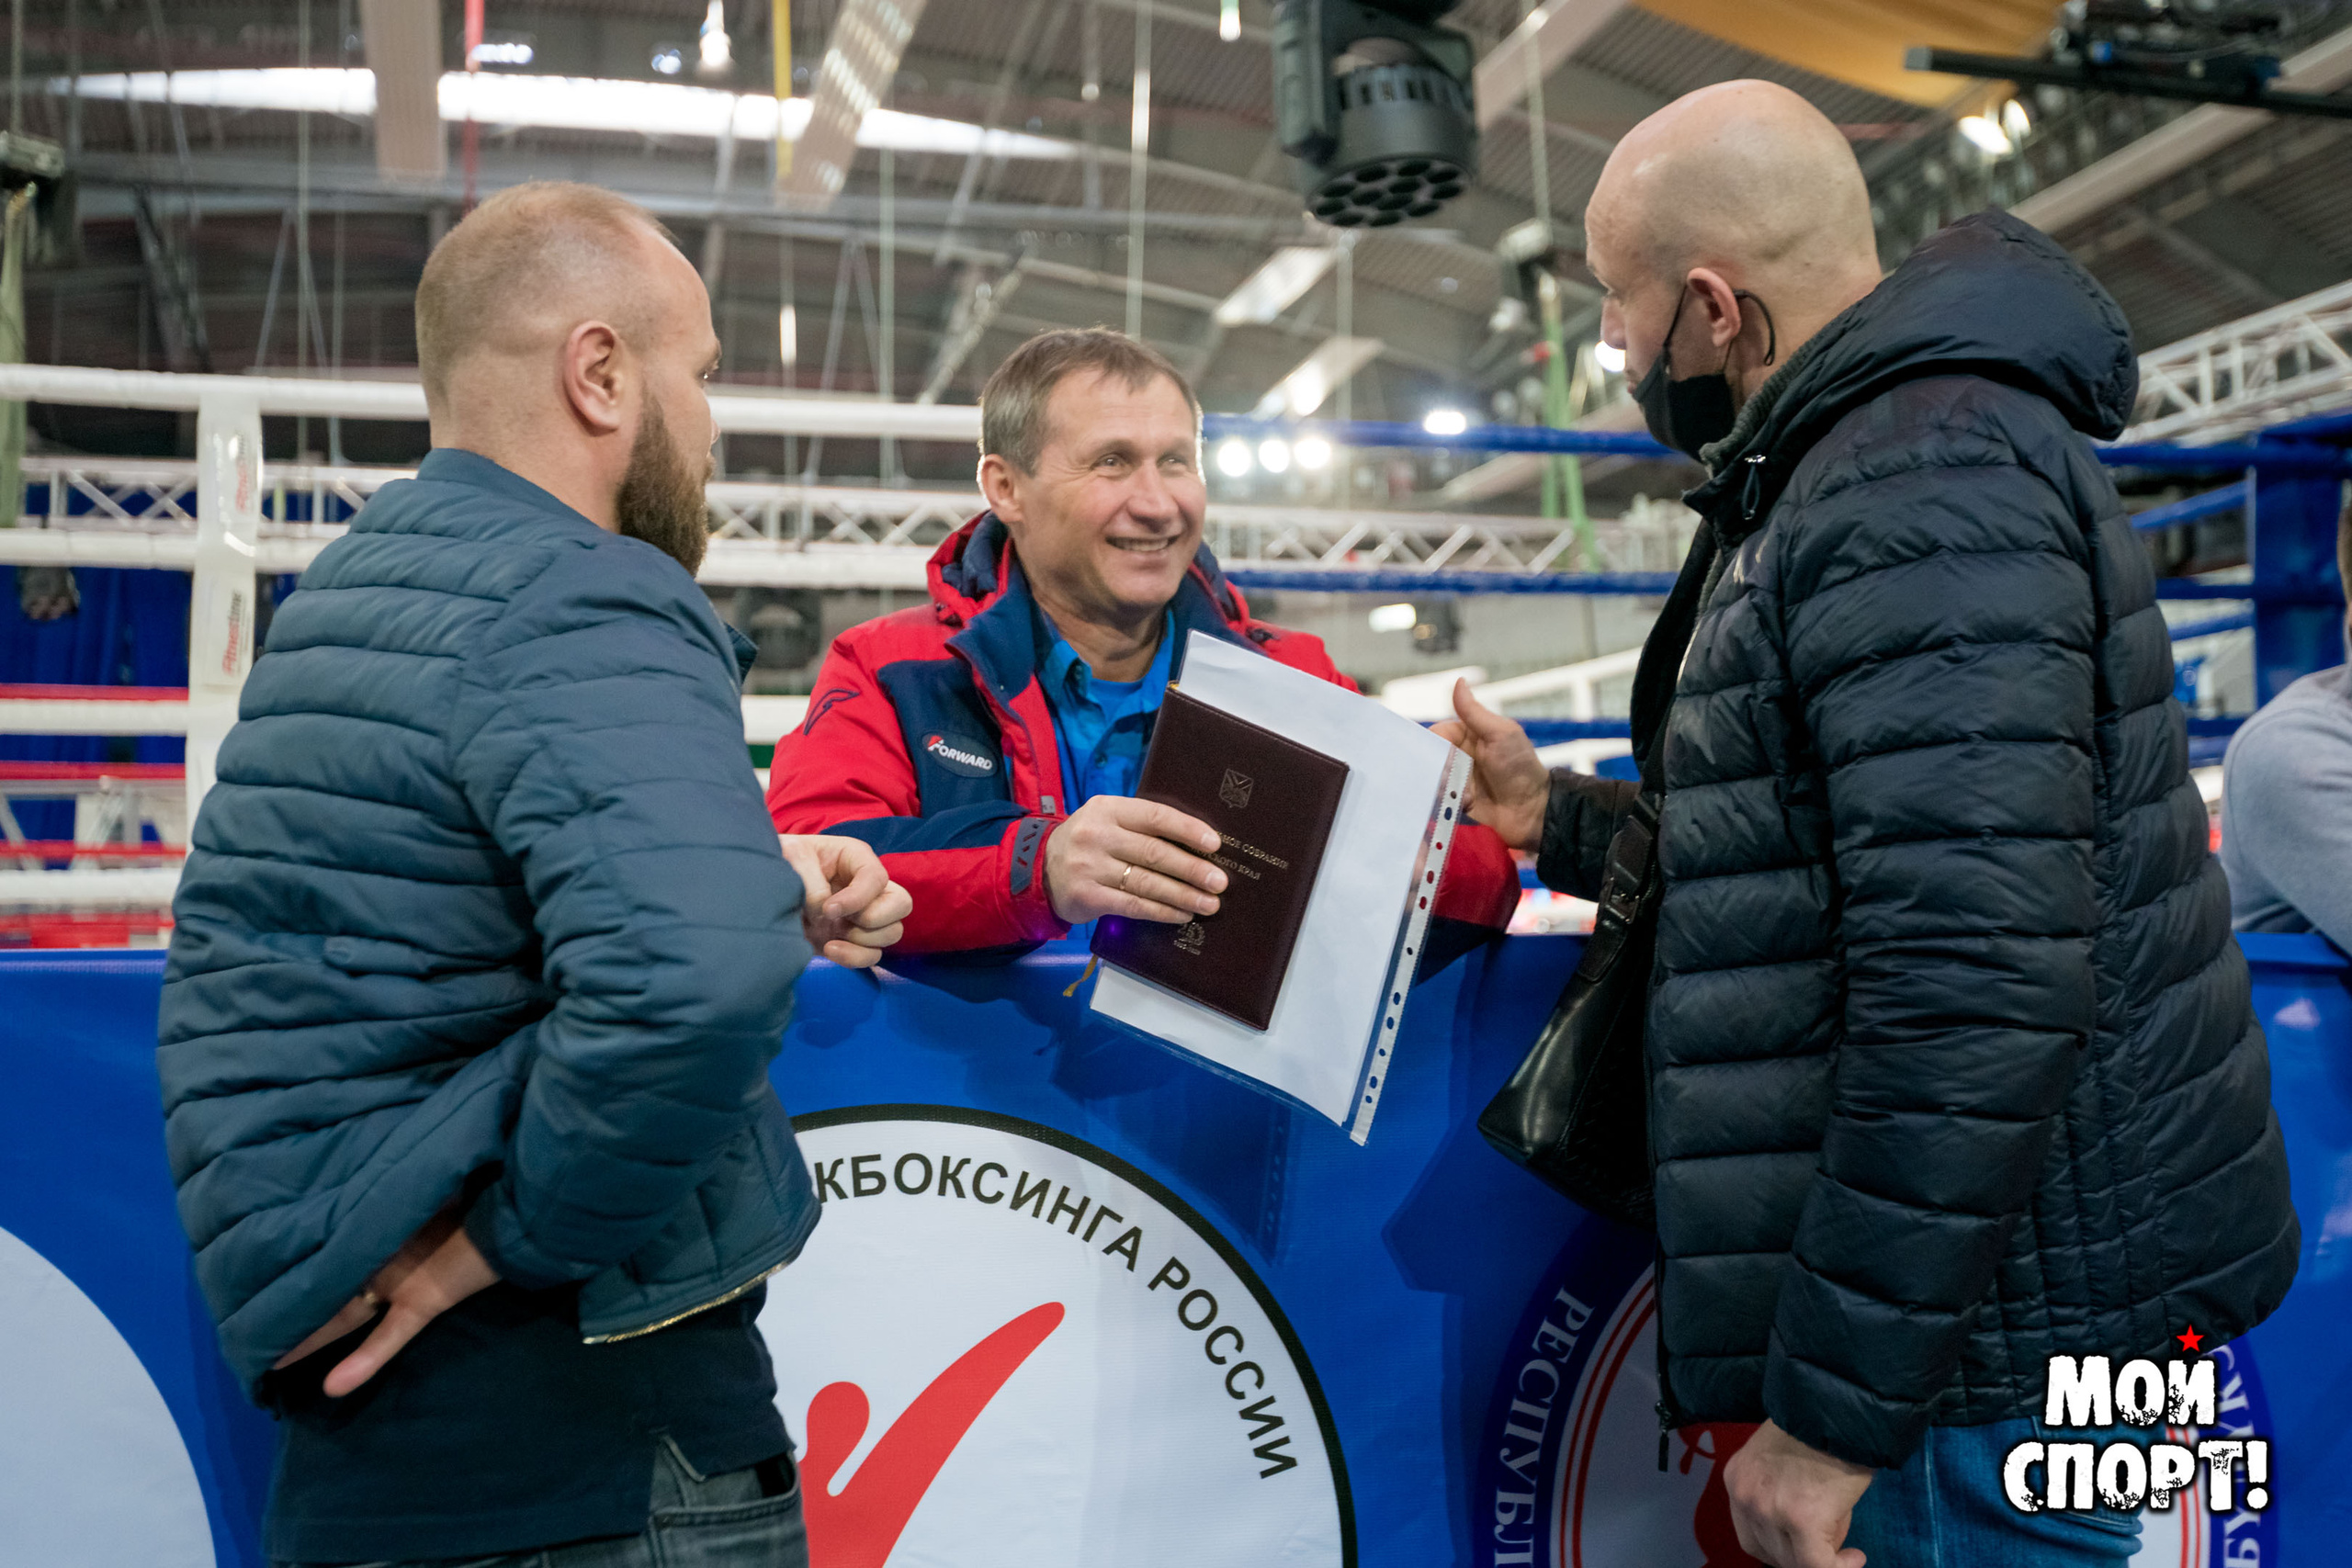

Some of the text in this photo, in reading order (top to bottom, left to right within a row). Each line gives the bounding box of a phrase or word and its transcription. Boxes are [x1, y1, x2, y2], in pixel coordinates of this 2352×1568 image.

[927, 735, 993, 770] FORWARD
[814, 1153, 1298, 1480] КБОКСИНГА РОССИИ
